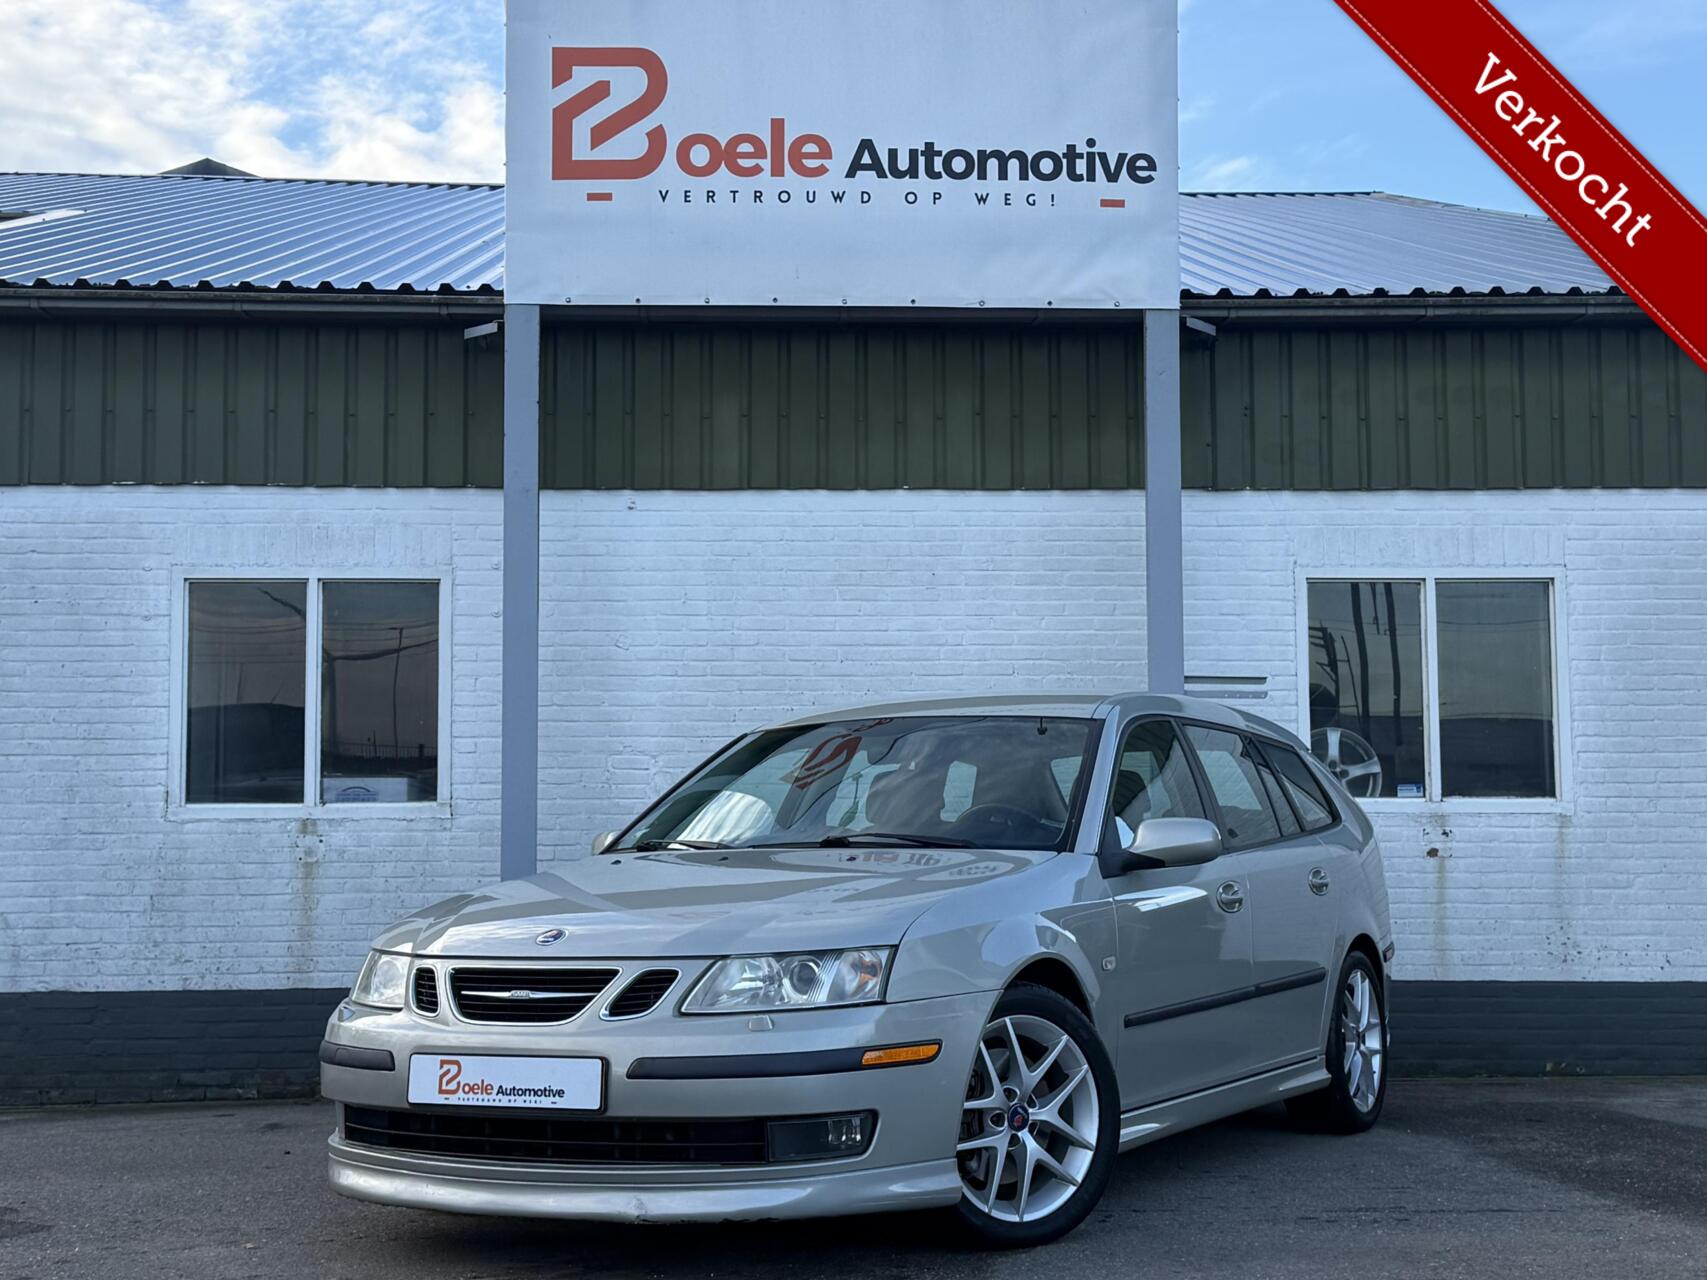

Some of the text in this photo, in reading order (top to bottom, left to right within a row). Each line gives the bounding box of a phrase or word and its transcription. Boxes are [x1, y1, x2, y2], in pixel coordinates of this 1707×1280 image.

[552, 47, 1157, 184] Boele Automotive
[658, 189, 1056, 207] VERTROUWD OP WEG!
[496, 1085, 565, 1099] Automotive
